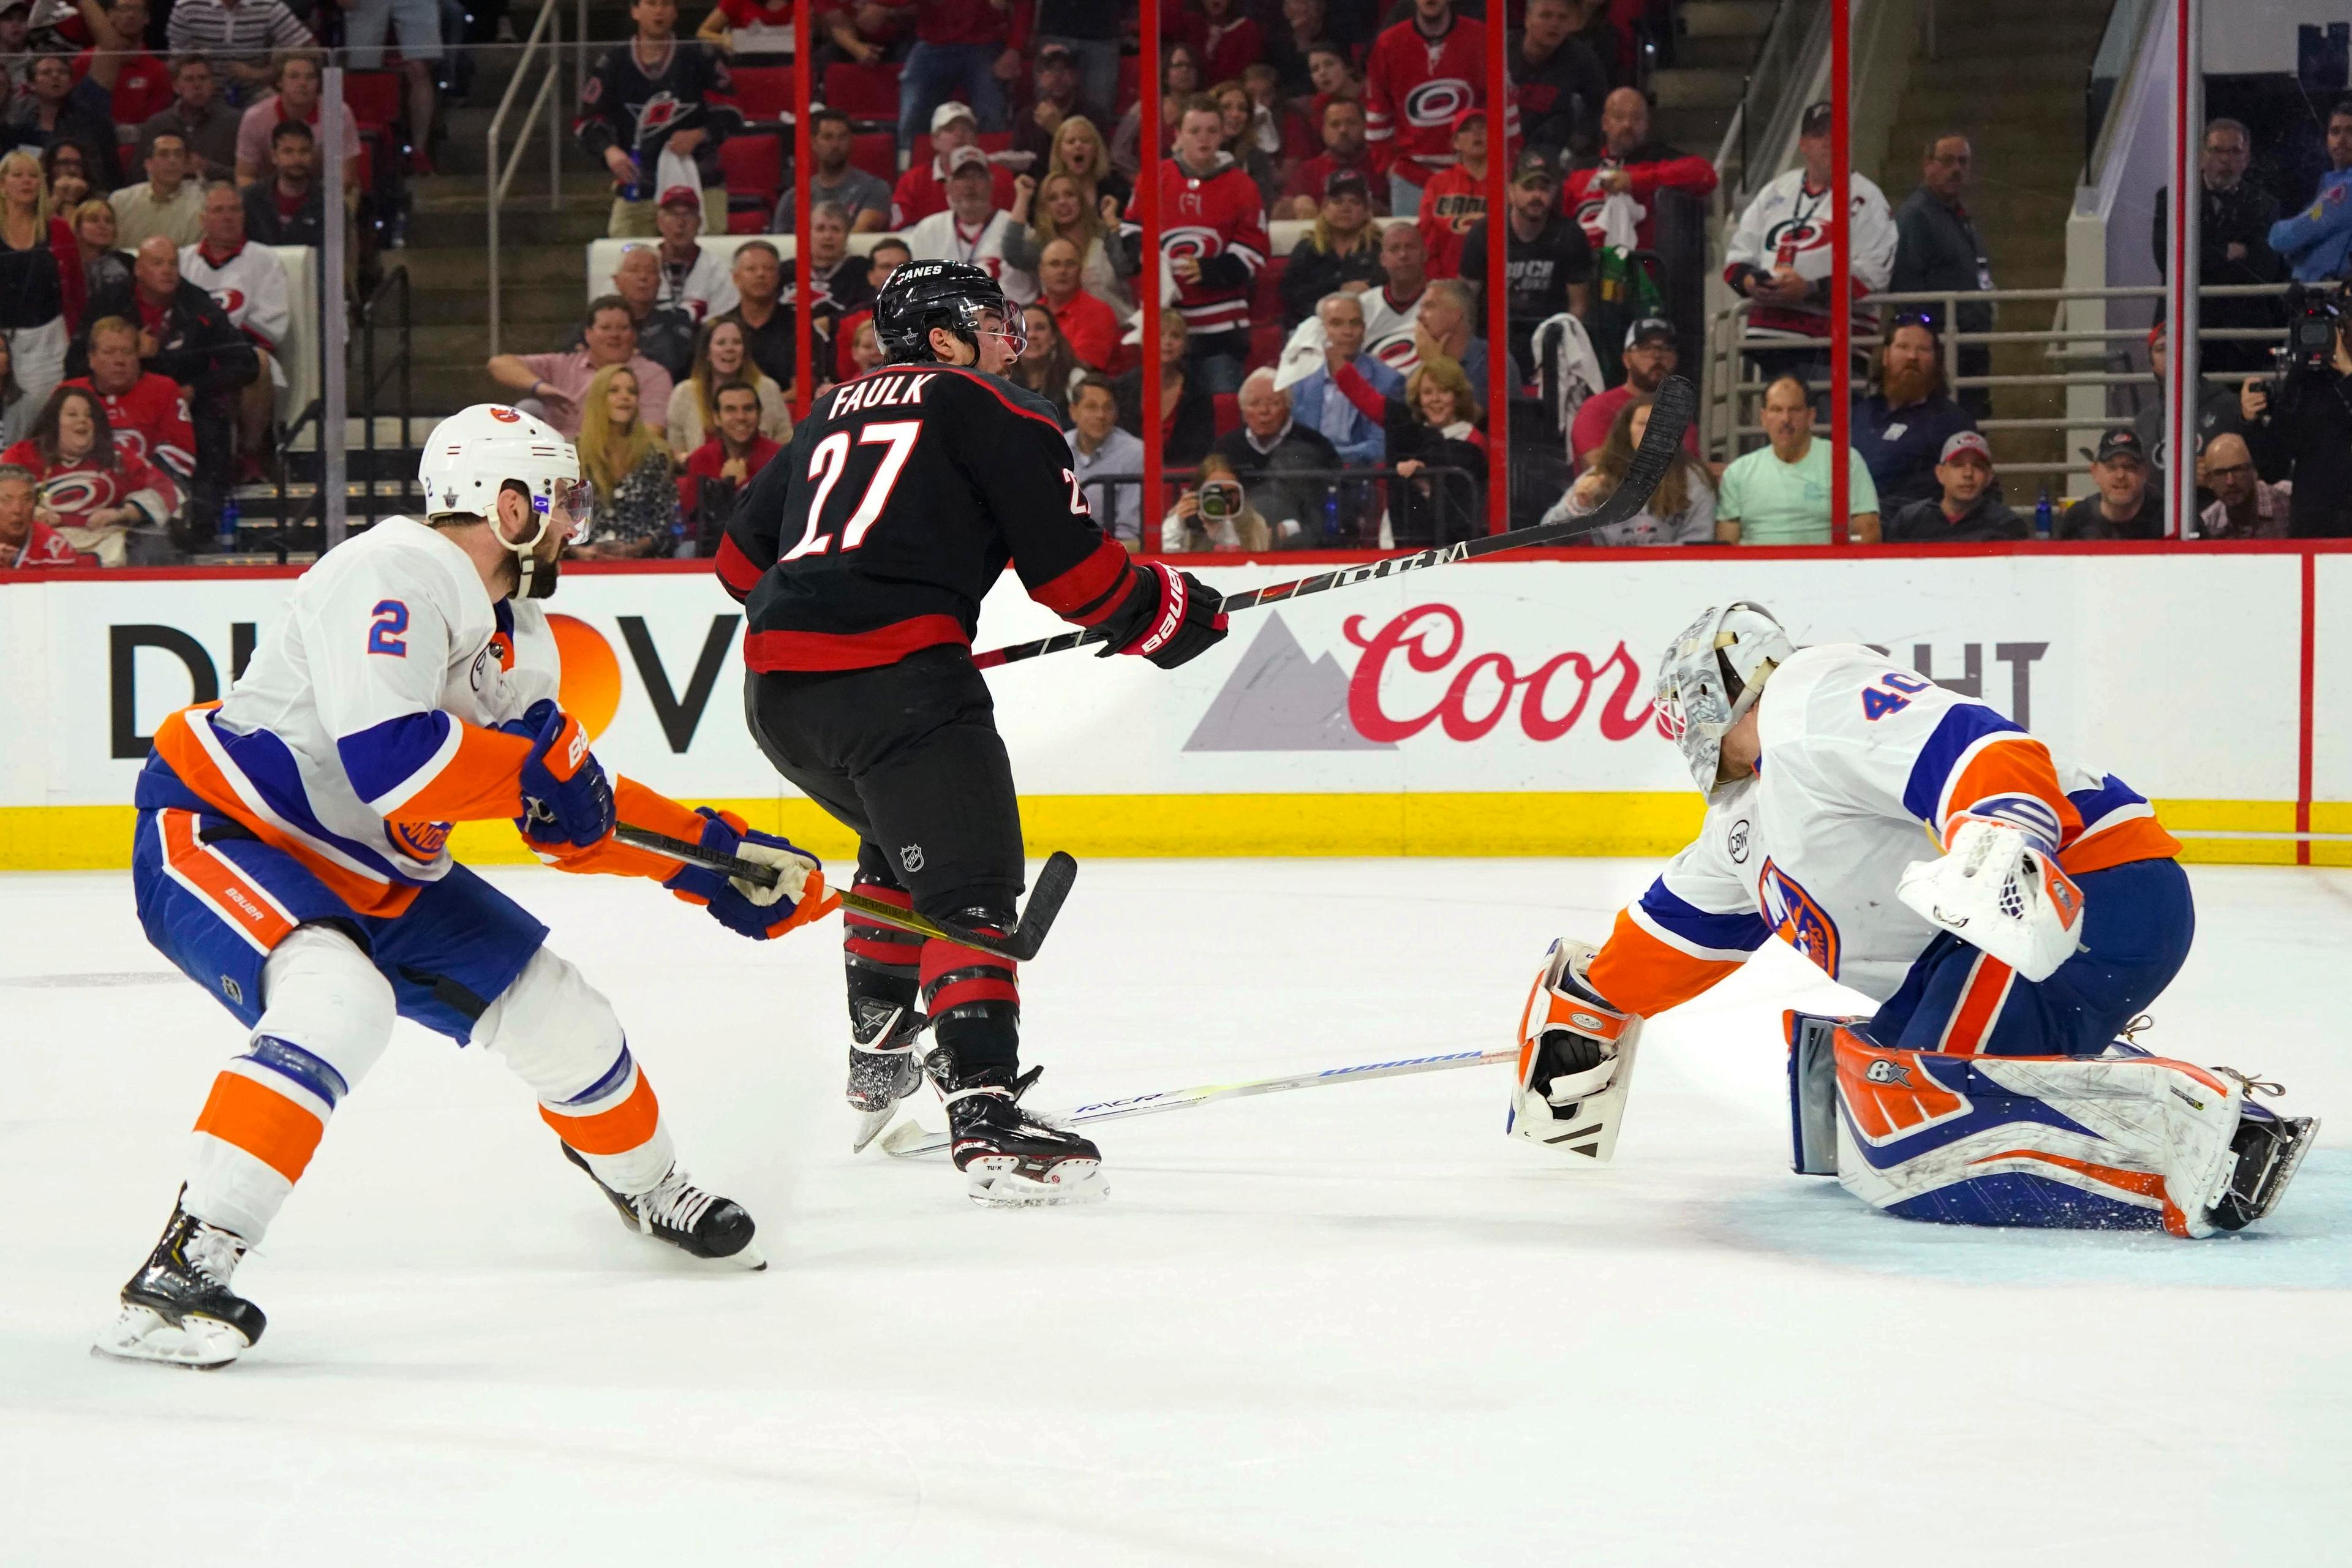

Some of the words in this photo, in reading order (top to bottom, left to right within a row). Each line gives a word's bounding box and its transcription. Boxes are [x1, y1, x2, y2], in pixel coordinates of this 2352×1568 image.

[827, 373, 938, 421] FAULK
[778, 419, 924, 564] 27
[1062, 467, 1091, 515] 2
[368, 599, 409, 658] 2
[1861, 673, 1933, 721] 40
[225, 888, 265, 921] BAUER
